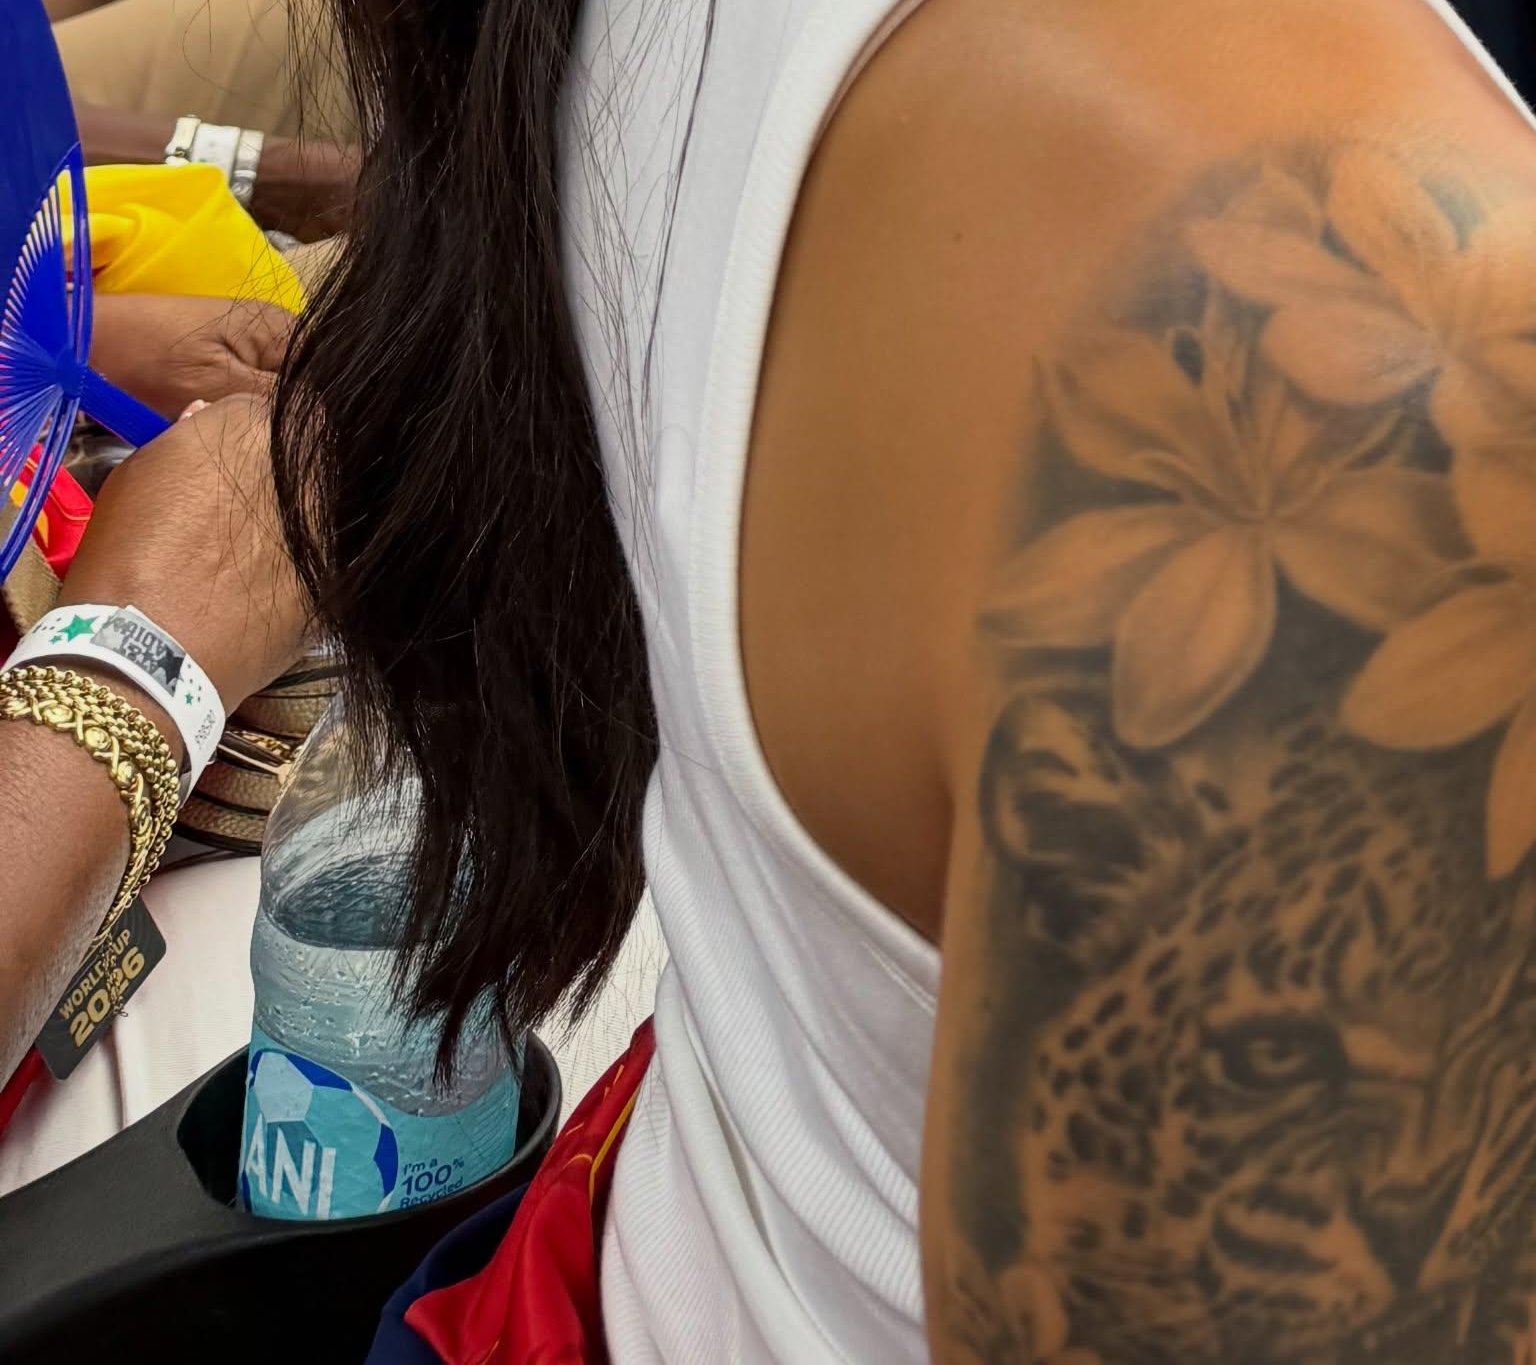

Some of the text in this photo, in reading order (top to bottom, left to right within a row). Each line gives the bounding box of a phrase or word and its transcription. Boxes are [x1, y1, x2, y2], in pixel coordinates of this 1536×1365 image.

[70, 946, 146, 1047] 2026
[403, 1158, 438, 1175] I'm a
